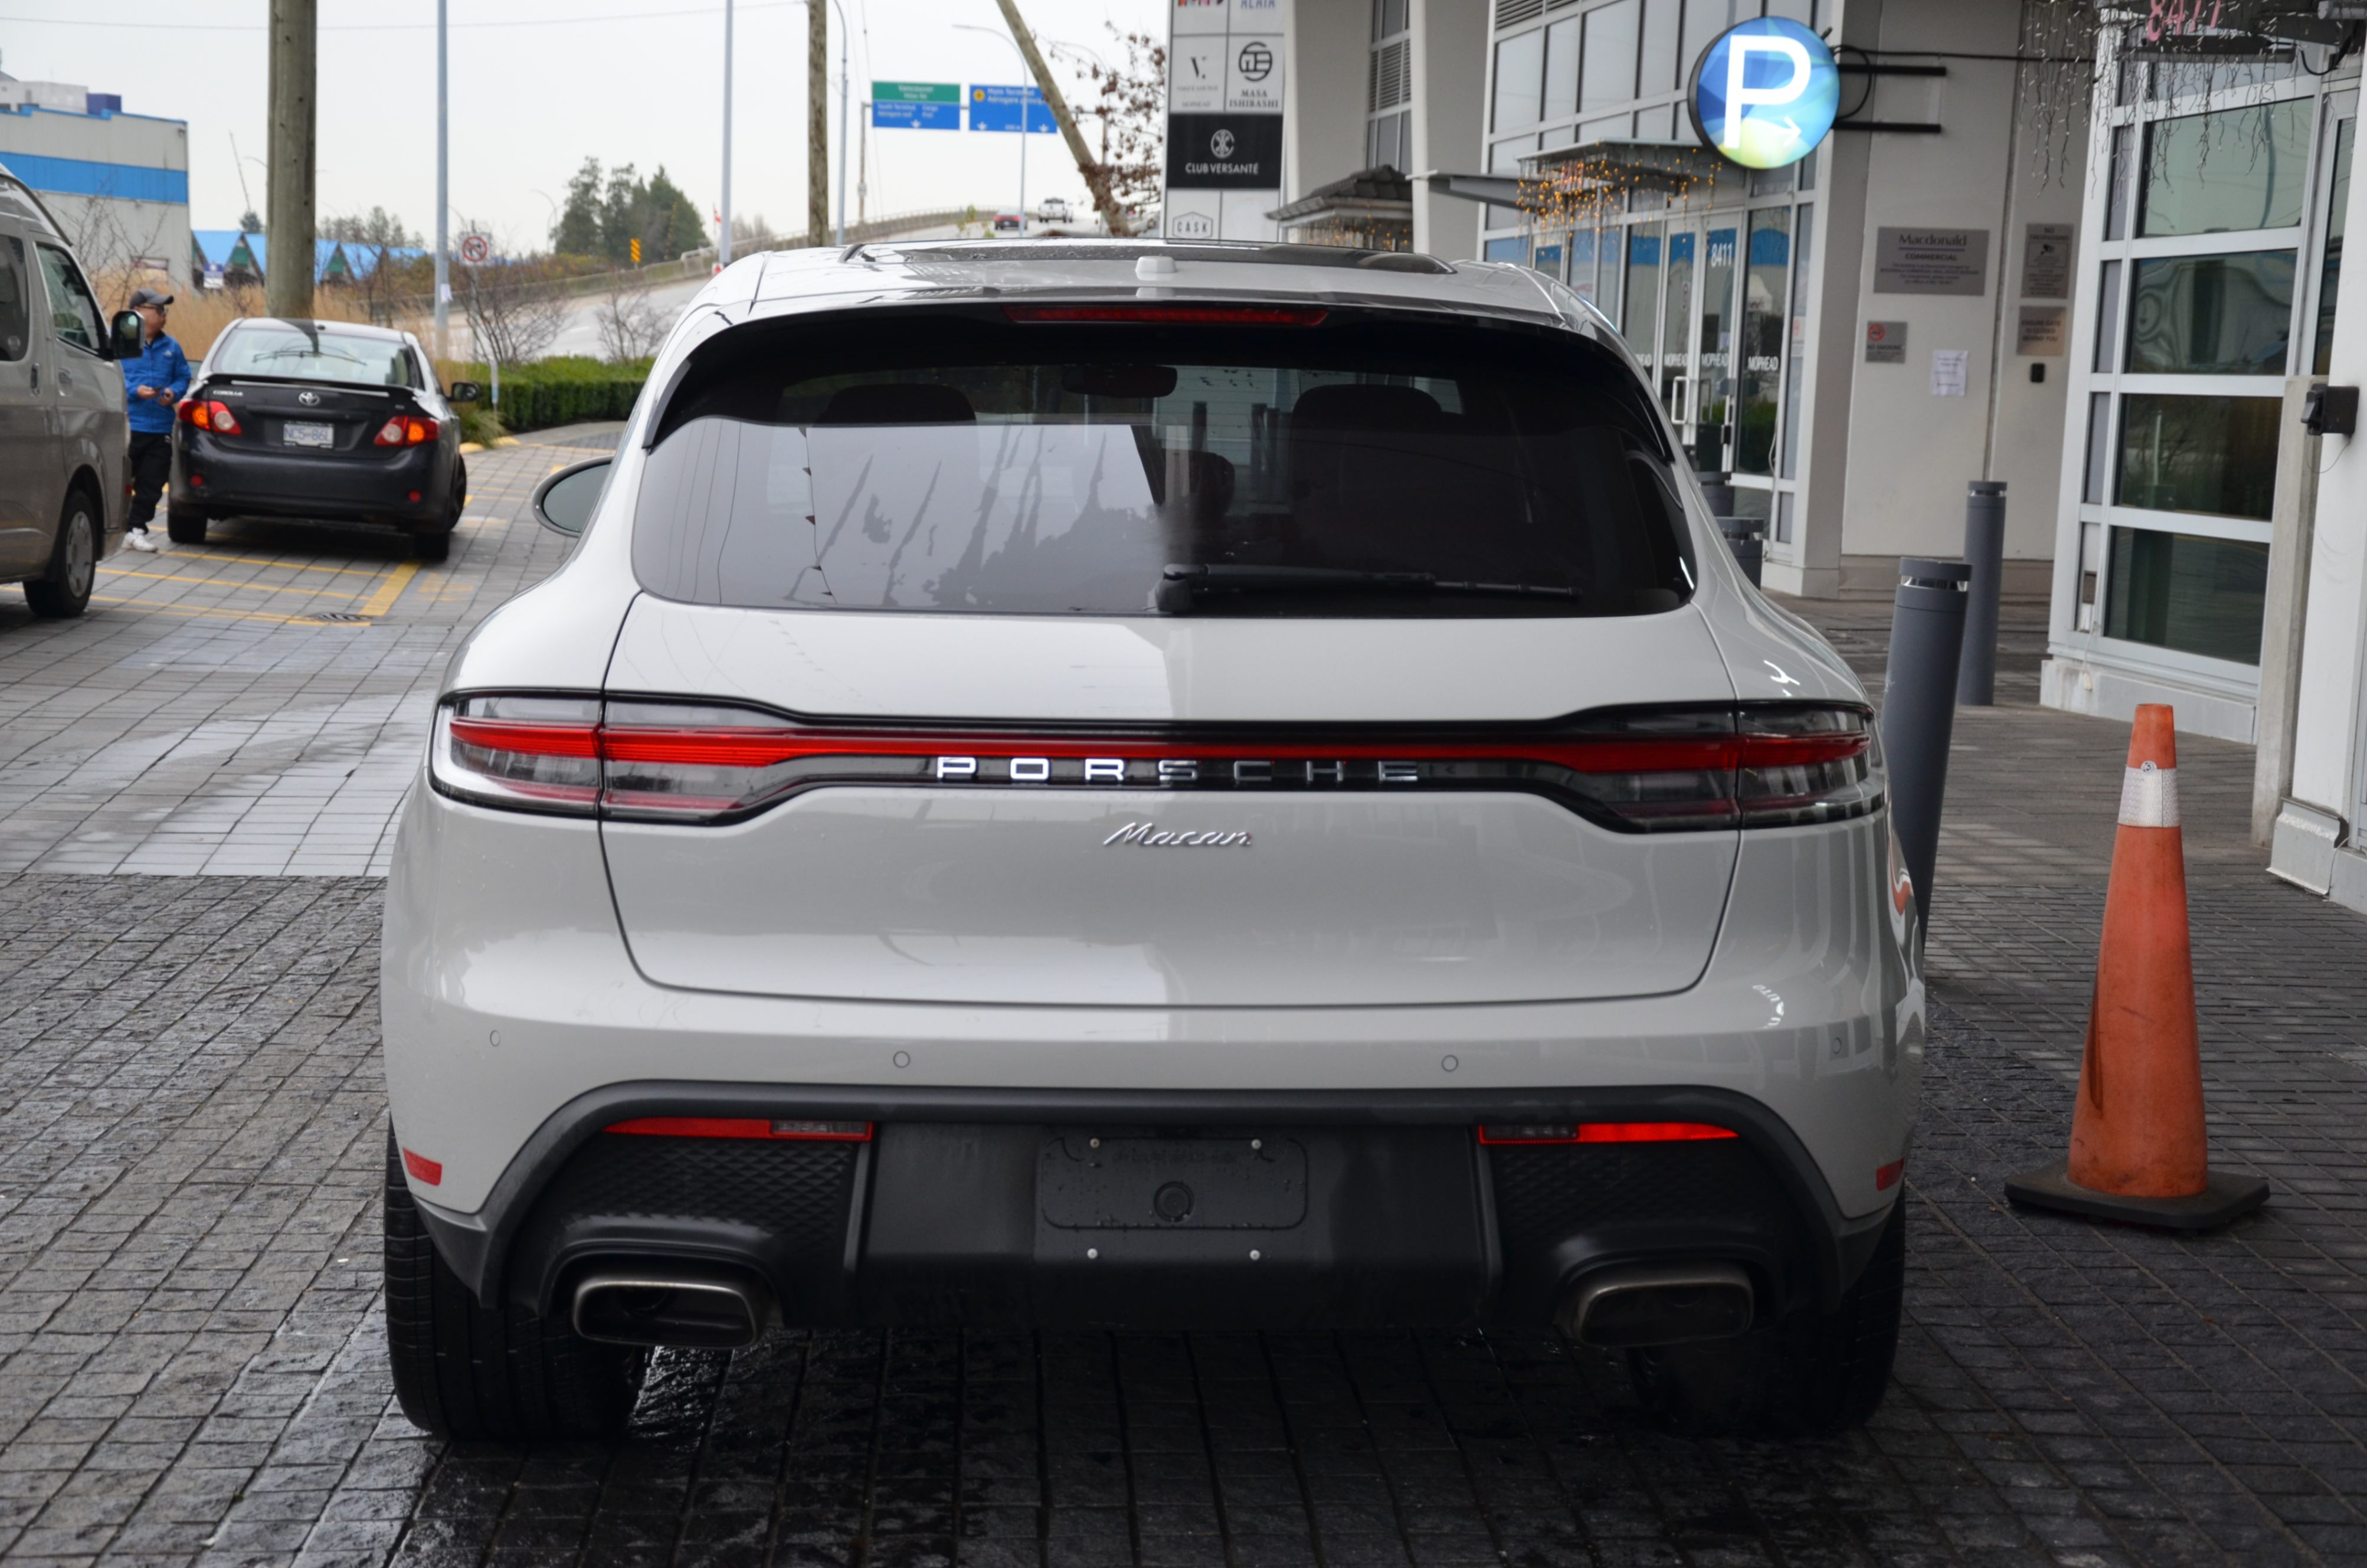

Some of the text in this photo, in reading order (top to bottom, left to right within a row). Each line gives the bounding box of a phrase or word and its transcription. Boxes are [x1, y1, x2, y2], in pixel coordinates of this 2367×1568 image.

[1724, 34, 1812, 149] P
[1229, 99, 1278, 107] ISHIBASHI
[1185, 162, 1209, 174] CLUB
[1177, 221, 1207, 233] CASK
[1898, 233, 1967, 246] Macdonald
[1711, 243, 1733, 267] 8411
[1904, 253, 1958, 261] COMMERCIAL
[1748, 356, 1779, 371] MOPHEAD
[937, 757, 1417, 781] PORSCHE
[1103, 821, 1252, 846] Macan
